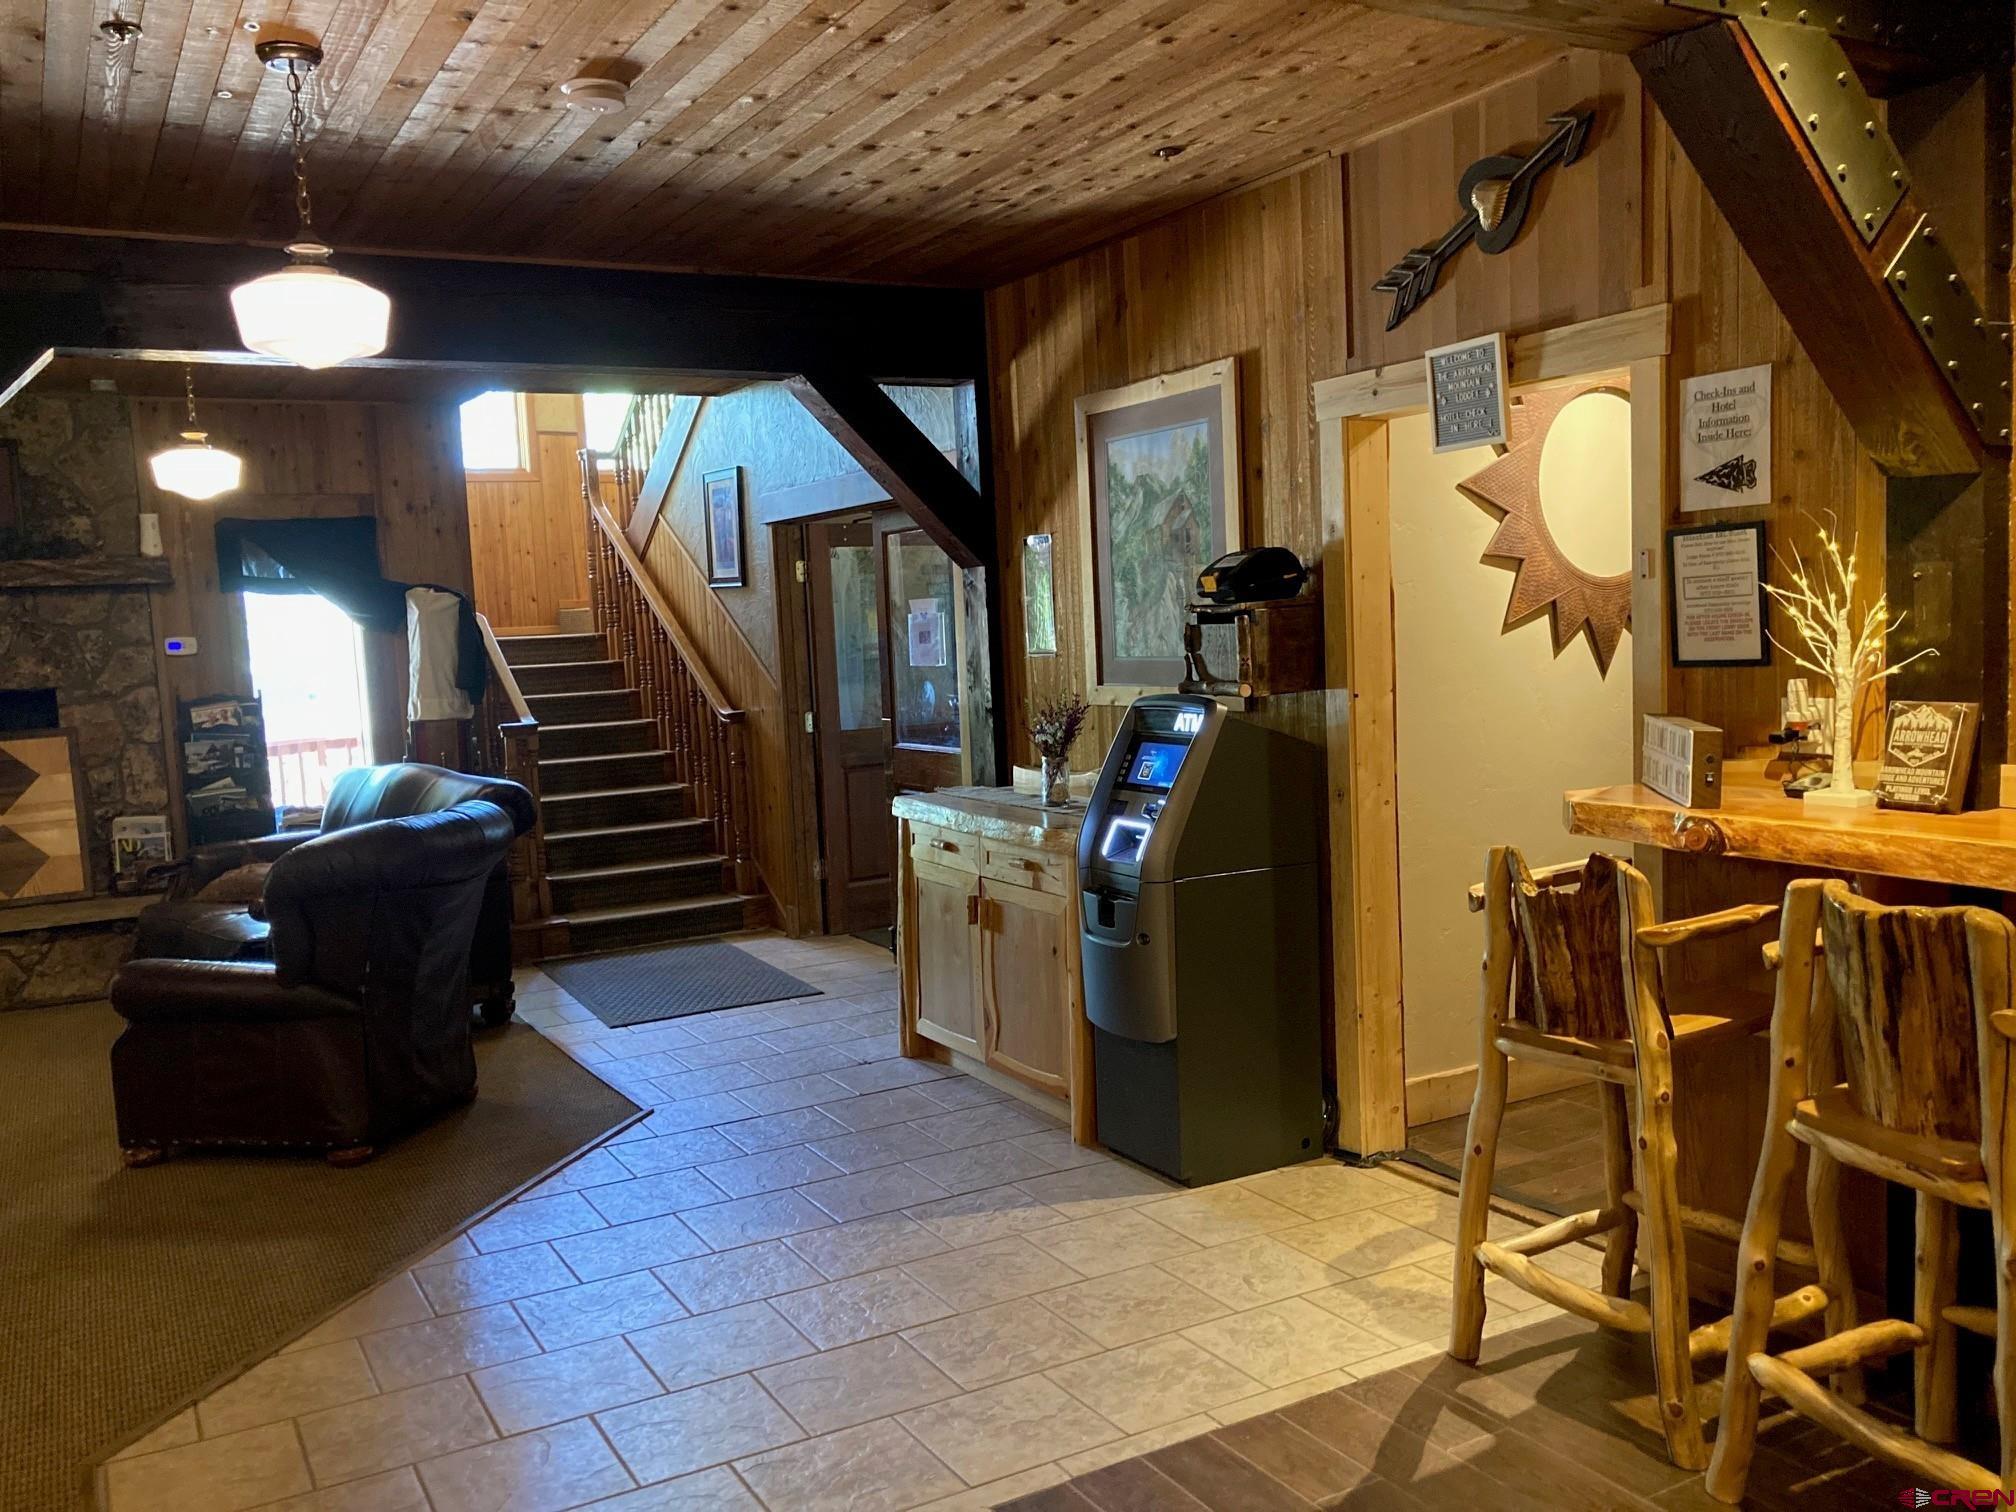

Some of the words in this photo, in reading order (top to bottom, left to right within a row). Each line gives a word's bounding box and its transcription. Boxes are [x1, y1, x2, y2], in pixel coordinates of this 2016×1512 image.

[1440, 352, 1471, 365] WELCOME
[1694, 386, 1737, 401] Check-Ins
[1739, 381, 1755, 394] and
[1711, 399, 1736, 413] Hotel
[1698, 415, 1750, 429] Information
[1698, 430, 1724, 444] Inside
[1893, 729, 1947, 743] ARROWHEAD
